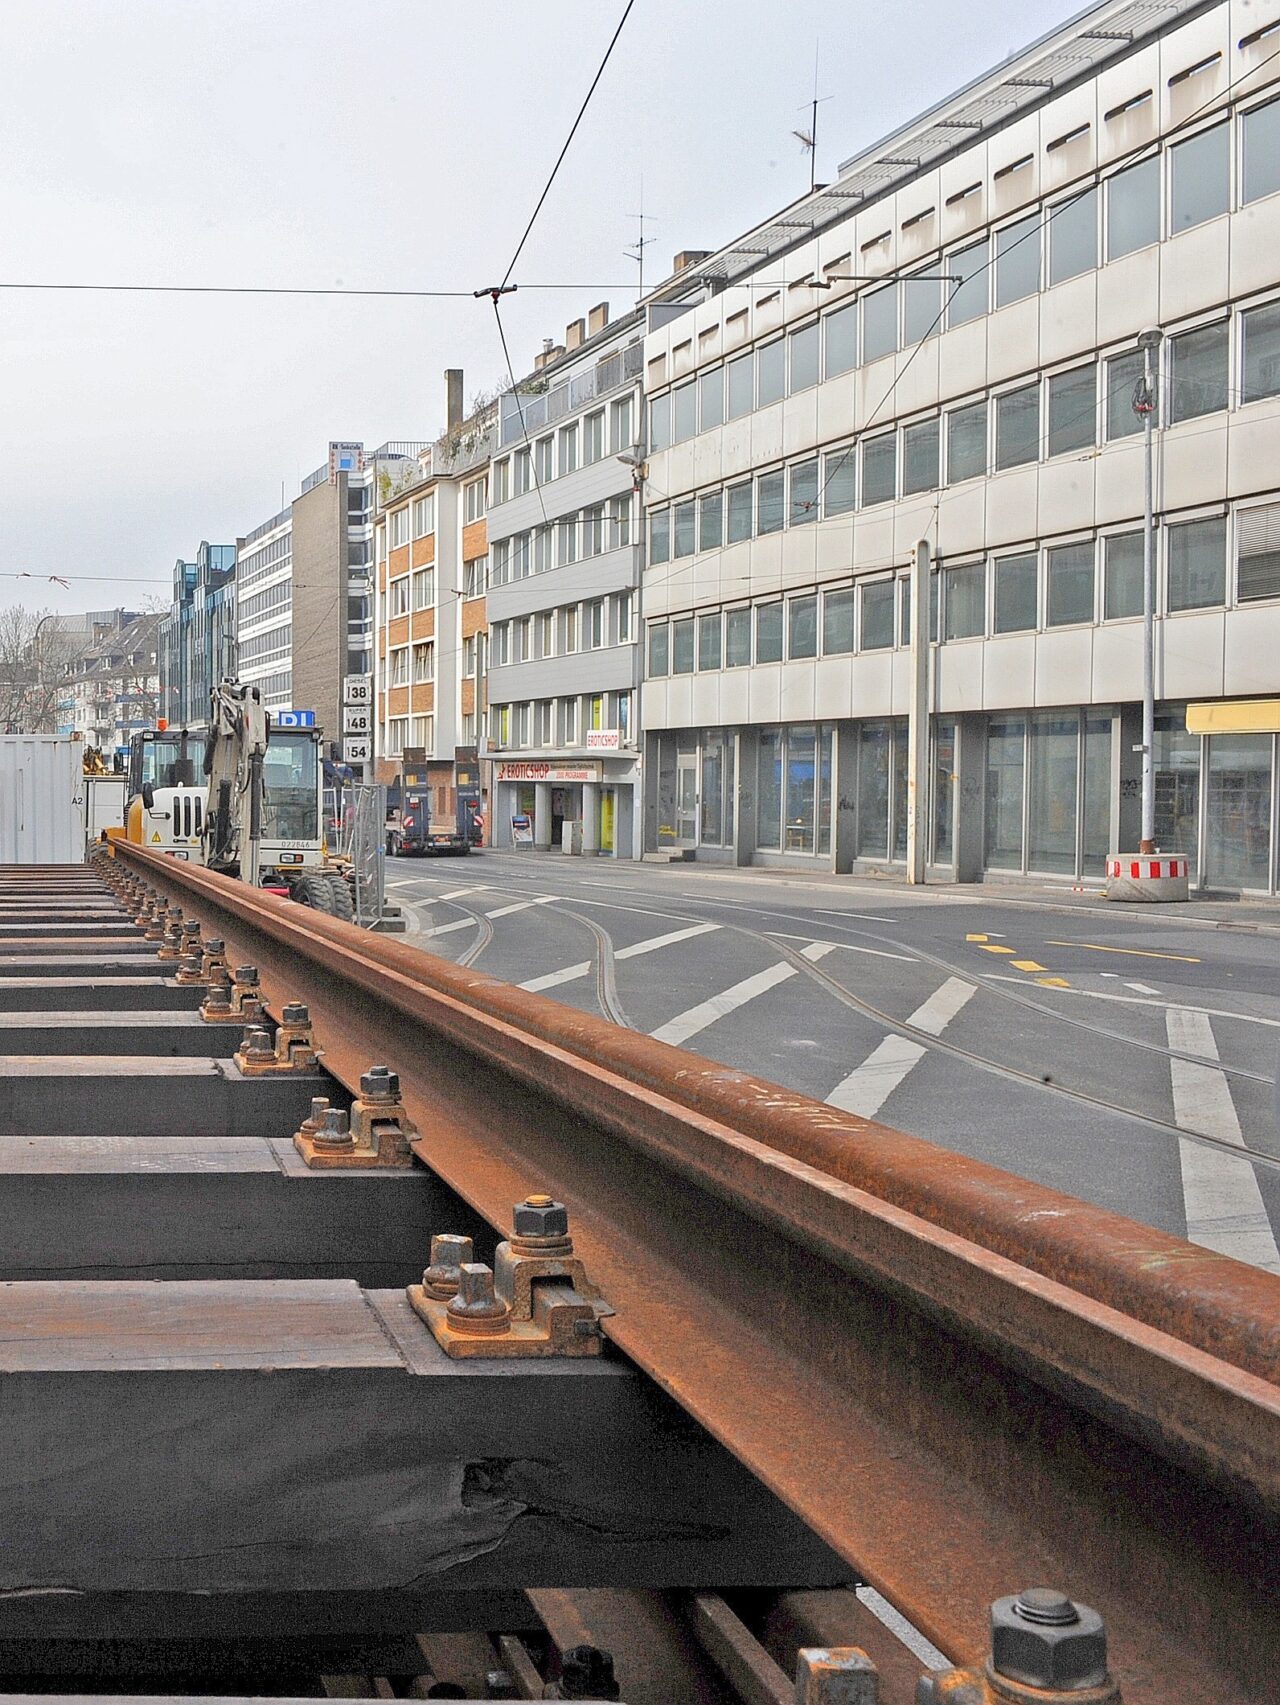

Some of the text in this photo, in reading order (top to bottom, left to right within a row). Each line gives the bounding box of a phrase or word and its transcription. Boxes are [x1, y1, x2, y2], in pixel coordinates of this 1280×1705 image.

[588, 735, 618, 747] EROTICSHOP
[507, 763, 550, 779] EROTICSHOP
[71, 796, 84, 805] A2
